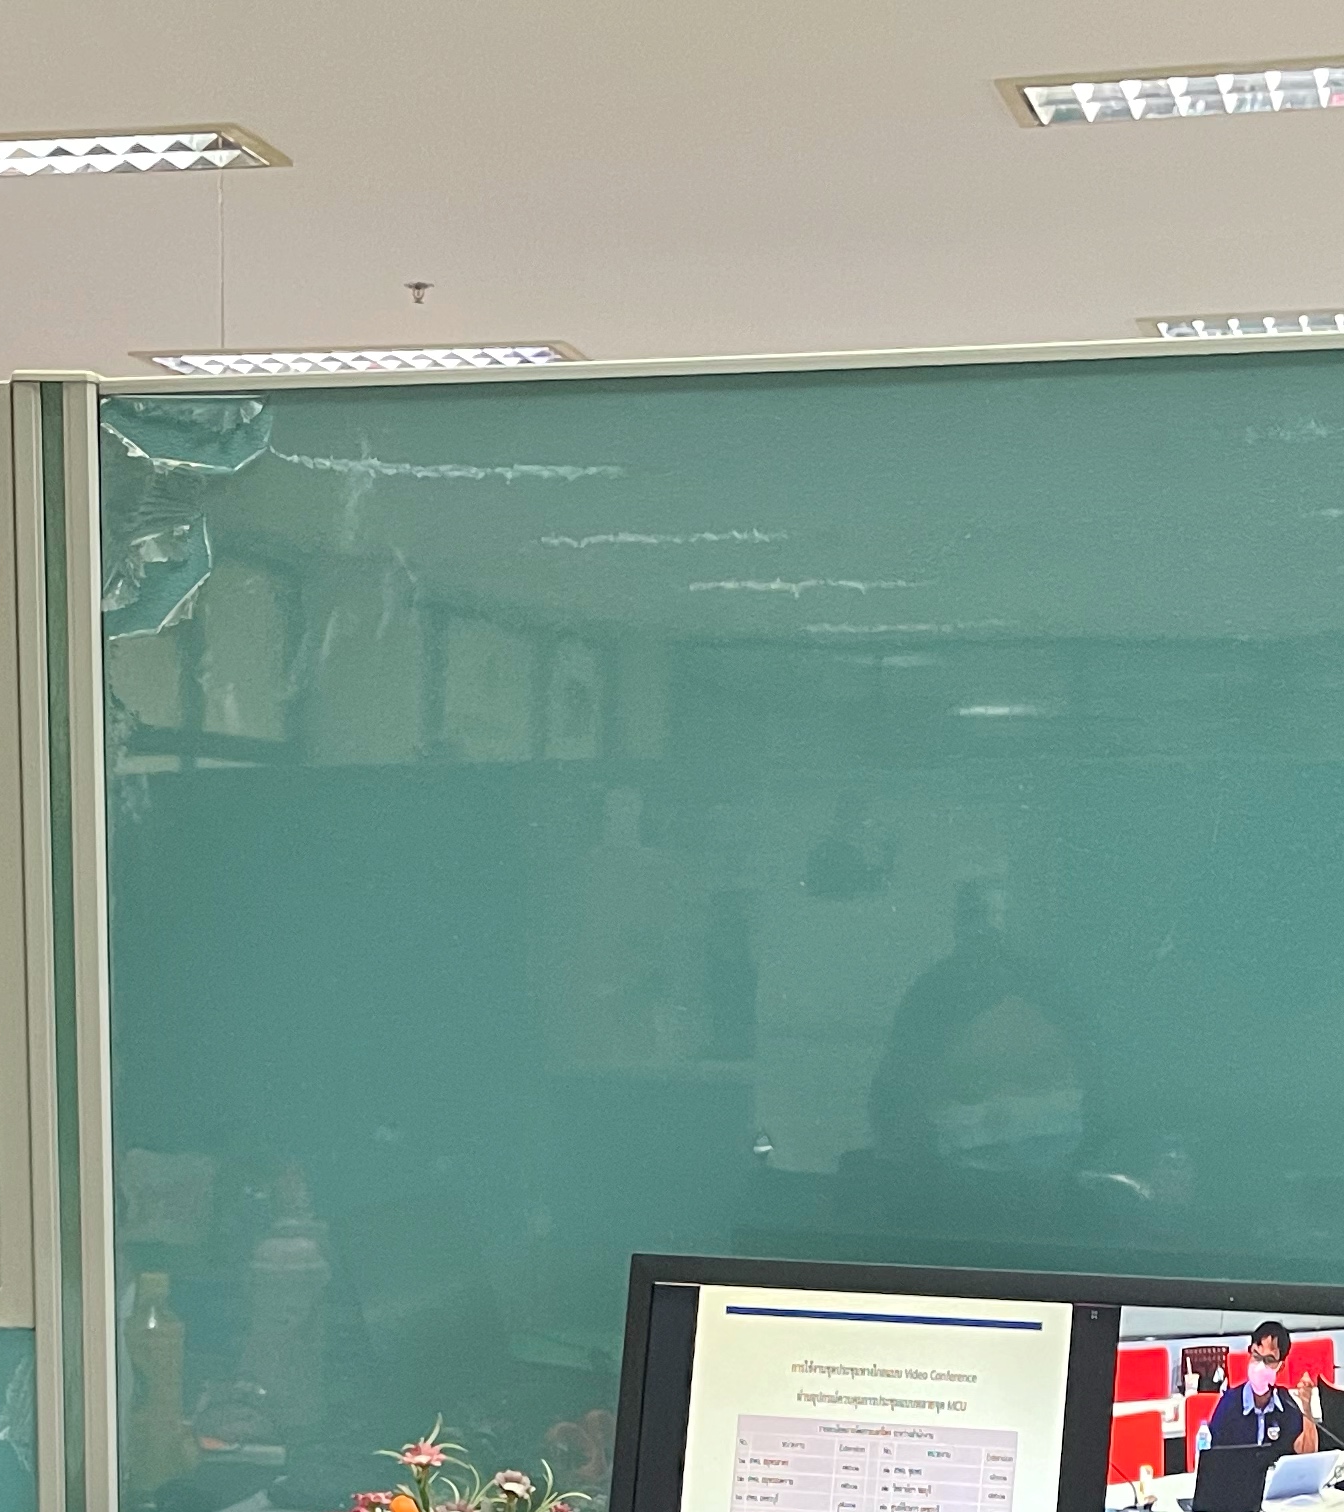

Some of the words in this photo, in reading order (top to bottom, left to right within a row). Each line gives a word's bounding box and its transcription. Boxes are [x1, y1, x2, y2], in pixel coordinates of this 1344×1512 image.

[905, 1368, 928, 1381] Video
[930, 1369, 978, 1384] Conference
[947, 1400, 967, 1412] MCU
